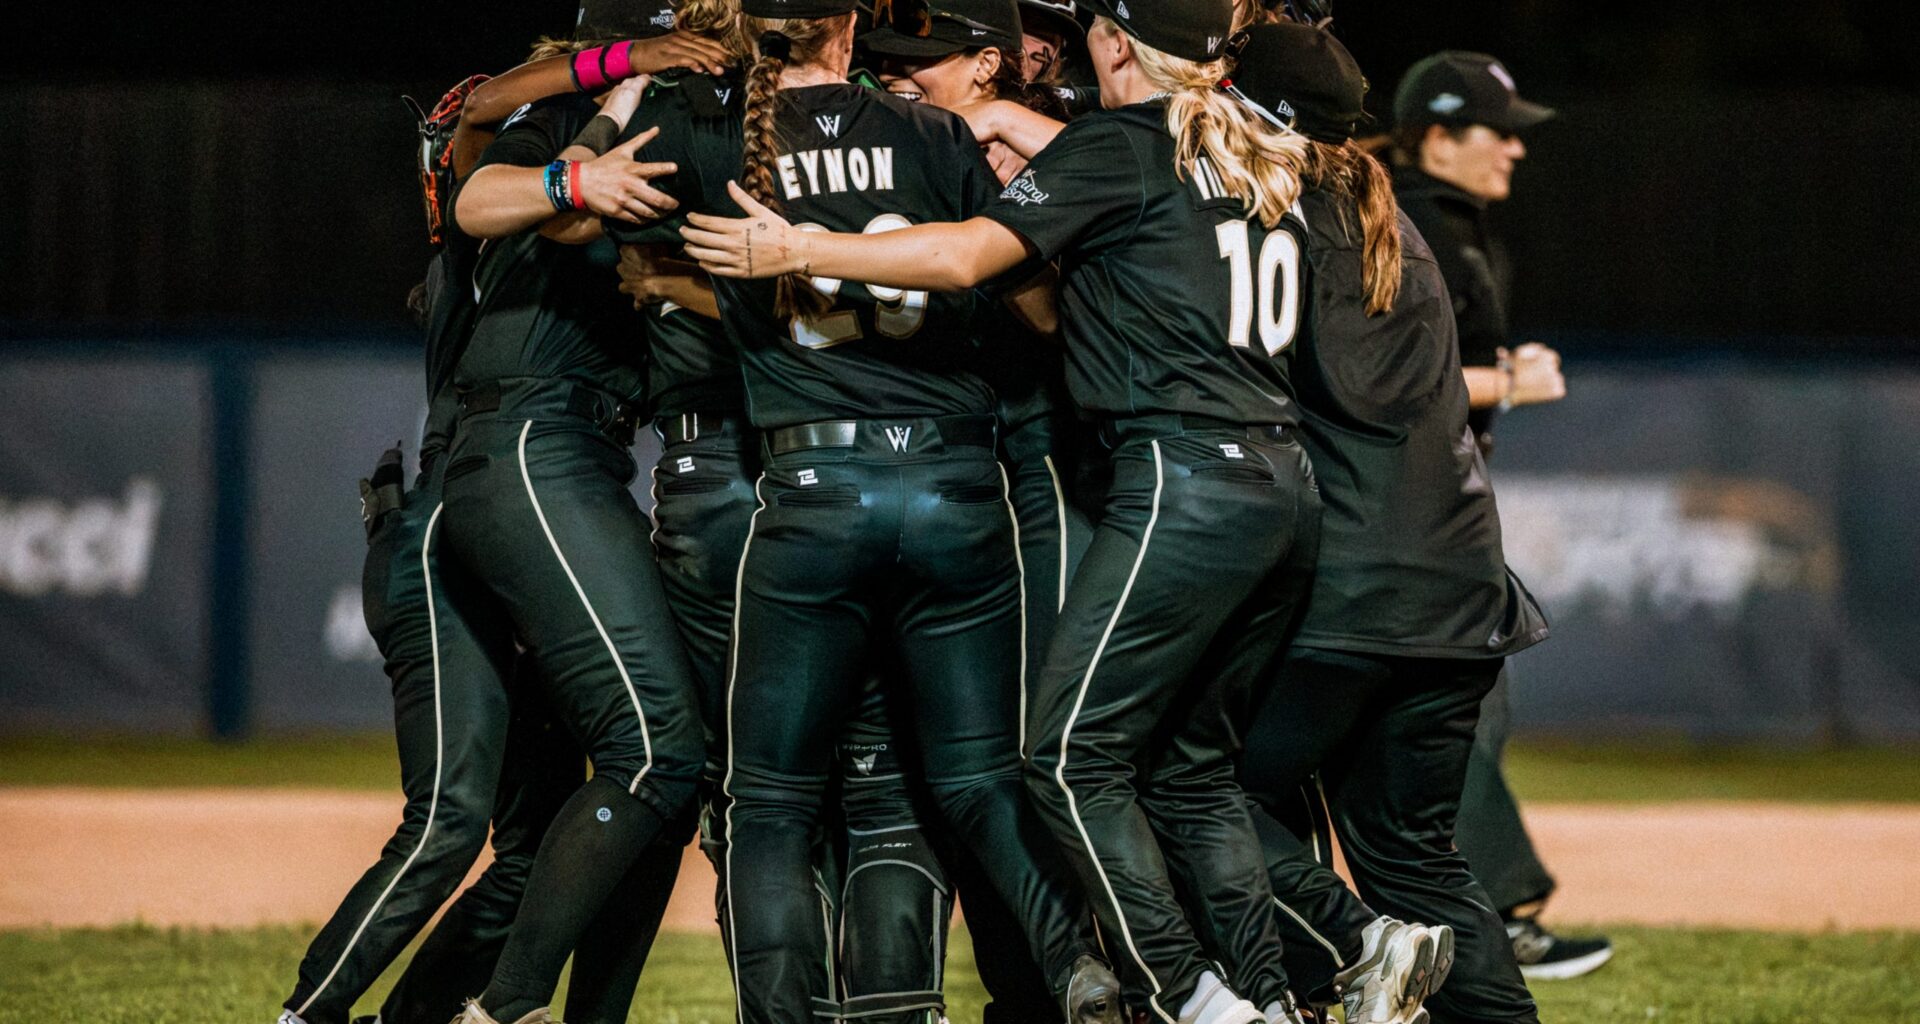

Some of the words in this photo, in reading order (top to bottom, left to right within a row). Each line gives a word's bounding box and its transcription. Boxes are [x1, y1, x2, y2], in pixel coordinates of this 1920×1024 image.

[815, 114, 841, 138] W
[775, 146, 894, 200] EYNON
[1215, 219, 1299, 357] 10
[885, 426, 912, 453] W
